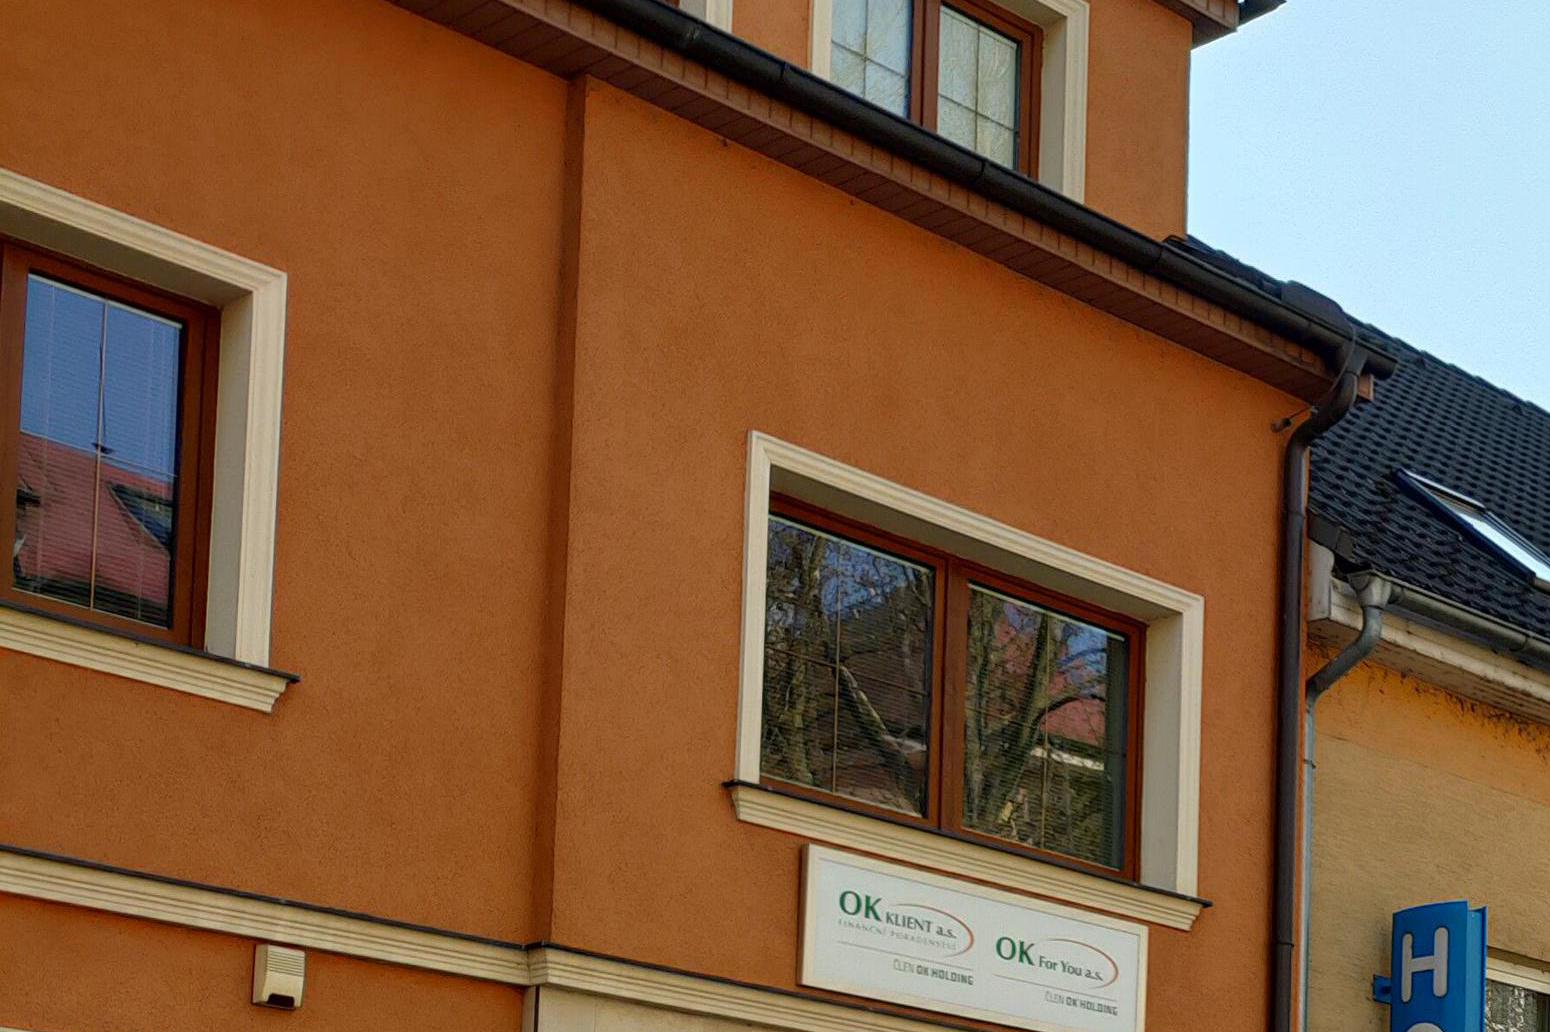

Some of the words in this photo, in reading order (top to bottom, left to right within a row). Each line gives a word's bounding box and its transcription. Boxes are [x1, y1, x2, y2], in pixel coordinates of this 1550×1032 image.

[839, 890, 882, 922] OK
[886, 911, 933, 934] KLIENT
[995, 936, 1035, 966] OK
[1039, 955, 1058, 971] For
[1061, 960, 1083, 977] You
[916, 965, 929, 976] OK
[931, 969, 975, 986] HOLDING
[1080, 1000, 1118, 1016] HOLDING
